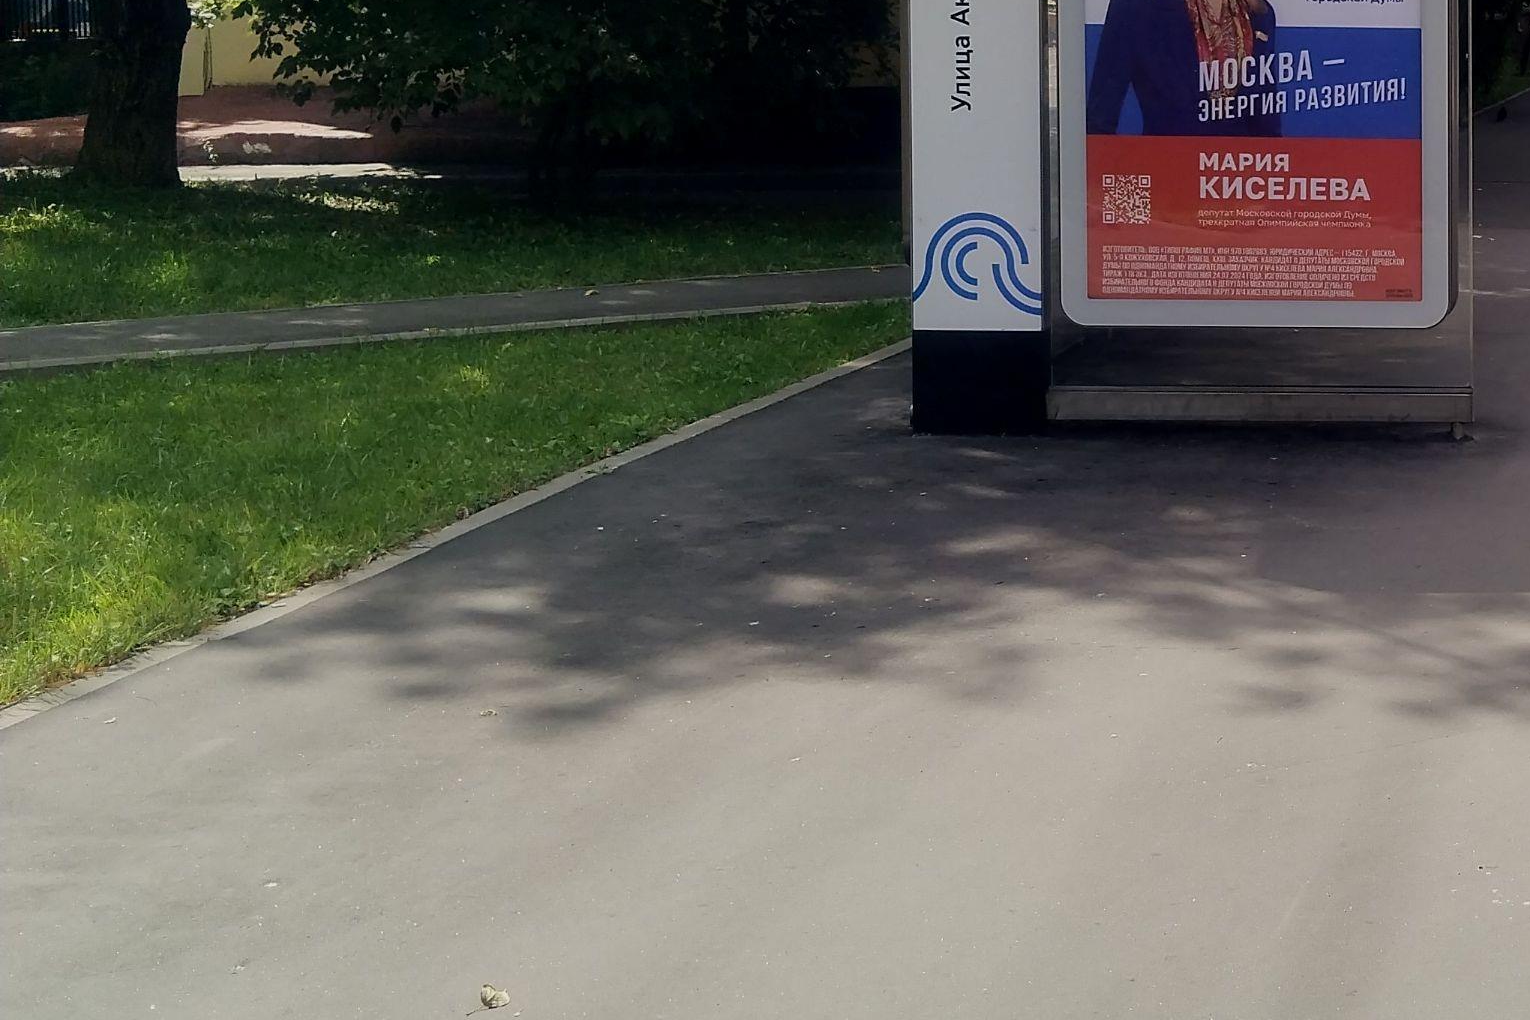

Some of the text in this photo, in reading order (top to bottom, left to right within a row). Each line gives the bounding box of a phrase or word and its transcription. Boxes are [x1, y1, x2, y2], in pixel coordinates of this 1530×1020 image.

[951, 35, 973, 112] Улица
[1199, 50, 1313, 92] МОСКВА
[1198, 77, 1407, 122] ЭНЕРГИЯ РАЗВИТИЯ!
[1199, 152, 1290, 171] МАРИЯ
[1199, 177, 1371, 201] КИСЕЛЕВА
[1236, 209, 1292, 218] Московской
[1293, 210, 1342, 219] городской
